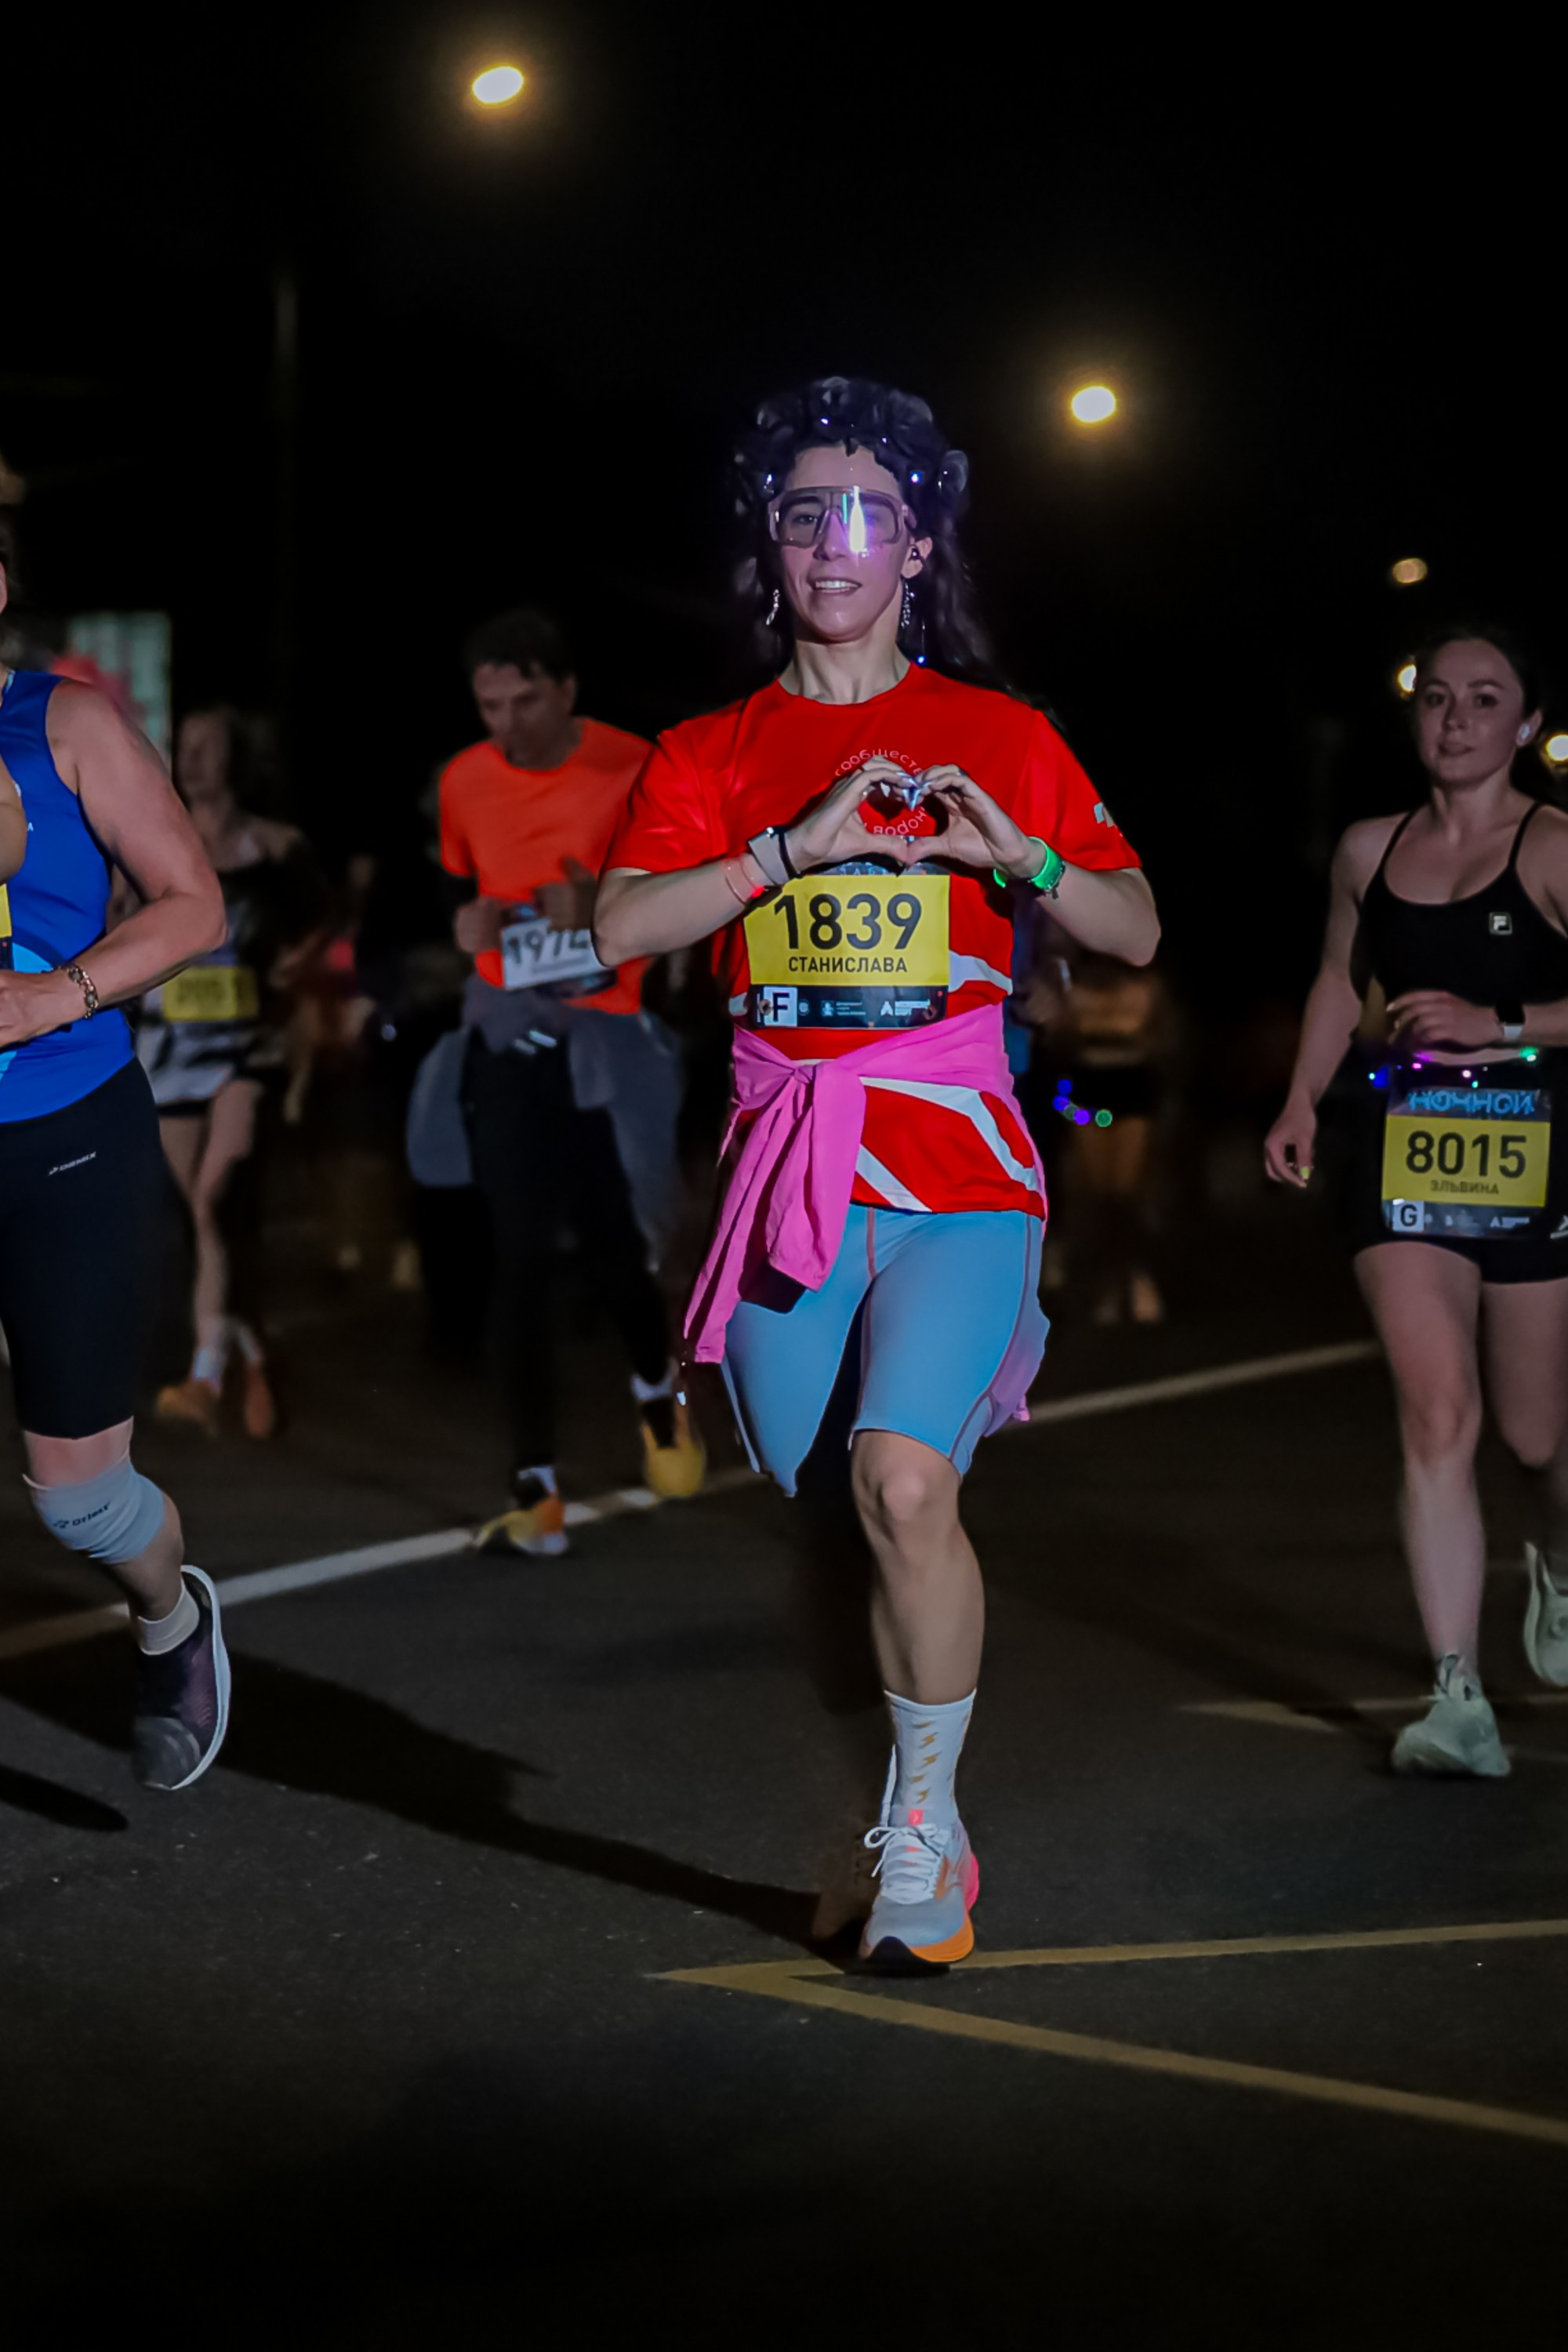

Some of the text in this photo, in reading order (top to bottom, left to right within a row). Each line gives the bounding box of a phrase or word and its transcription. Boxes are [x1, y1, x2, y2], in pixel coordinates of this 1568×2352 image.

[772, 892, 923, 951] 1839
[788, 956, 908, 974] СТАНИСЛАВА
[773, 992, 789, 1022] F
[1408, 1090, 1535, 1115] НОЧНОЙ
[1406, 1130, 1527, 1179] 8015
[1399, 1203, 1418, 1228] G
